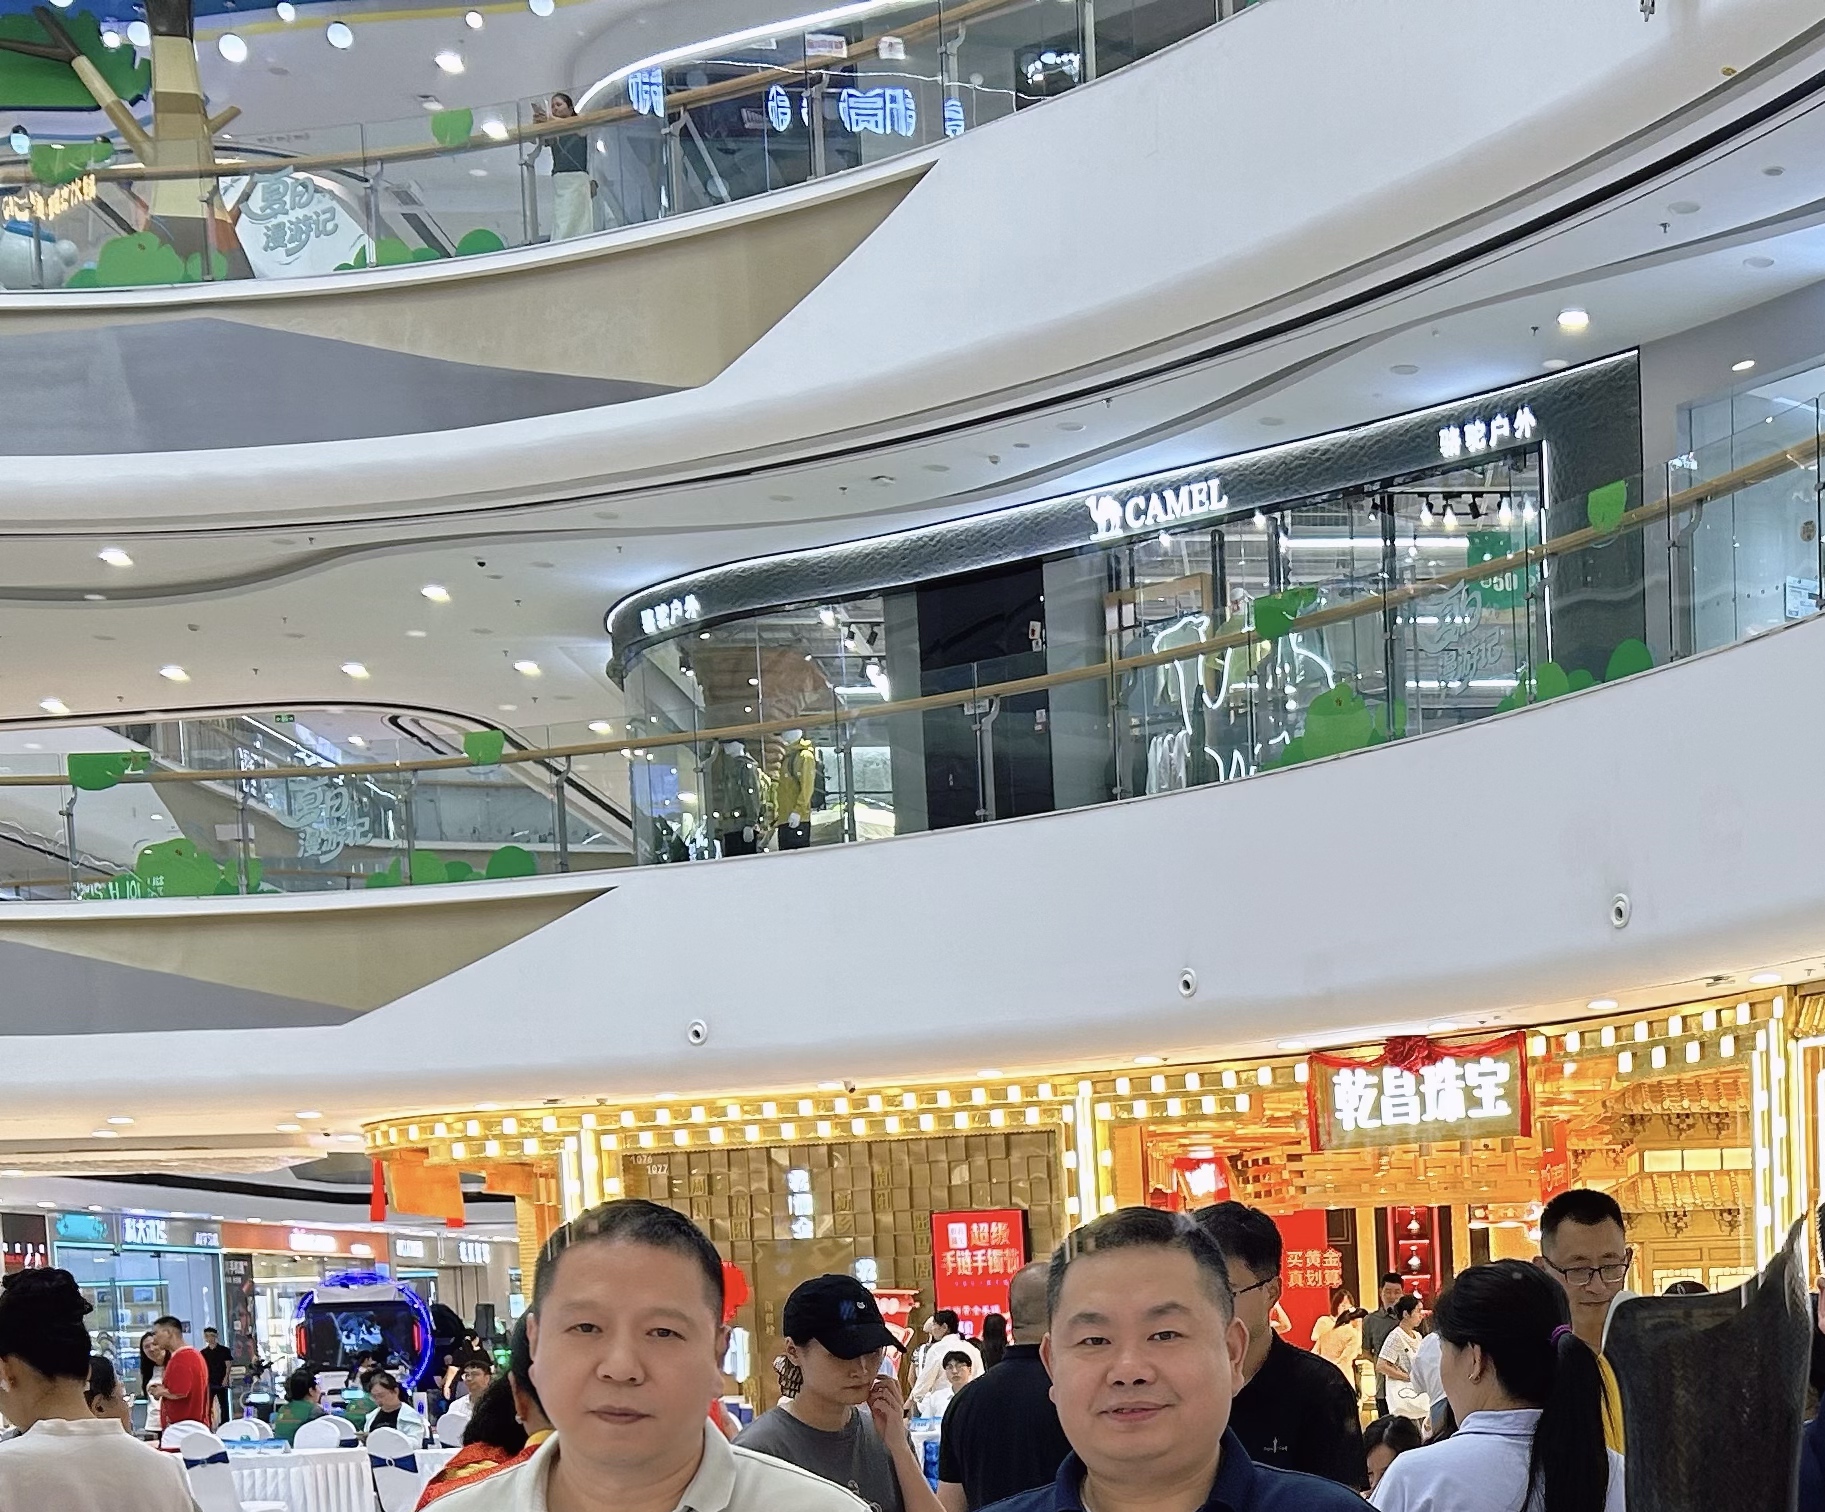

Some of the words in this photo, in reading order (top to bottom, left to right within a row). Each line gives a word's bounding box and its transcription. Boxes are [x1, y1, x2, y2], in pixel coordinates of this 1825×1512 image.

[263, 205, 340, 258] 漫游记
[1125, 478, 1229, 529] CAMEL
[1332, 1056, 1512, 1131] 乾昌珠宝
[647, 1164, 669, 1174] 1077
[970, 1221, 1011, 1246] 超级
[1286, 1247, 1342, 1268] 买黄金
[1287, 1268, 1343, 1289] 真划算
